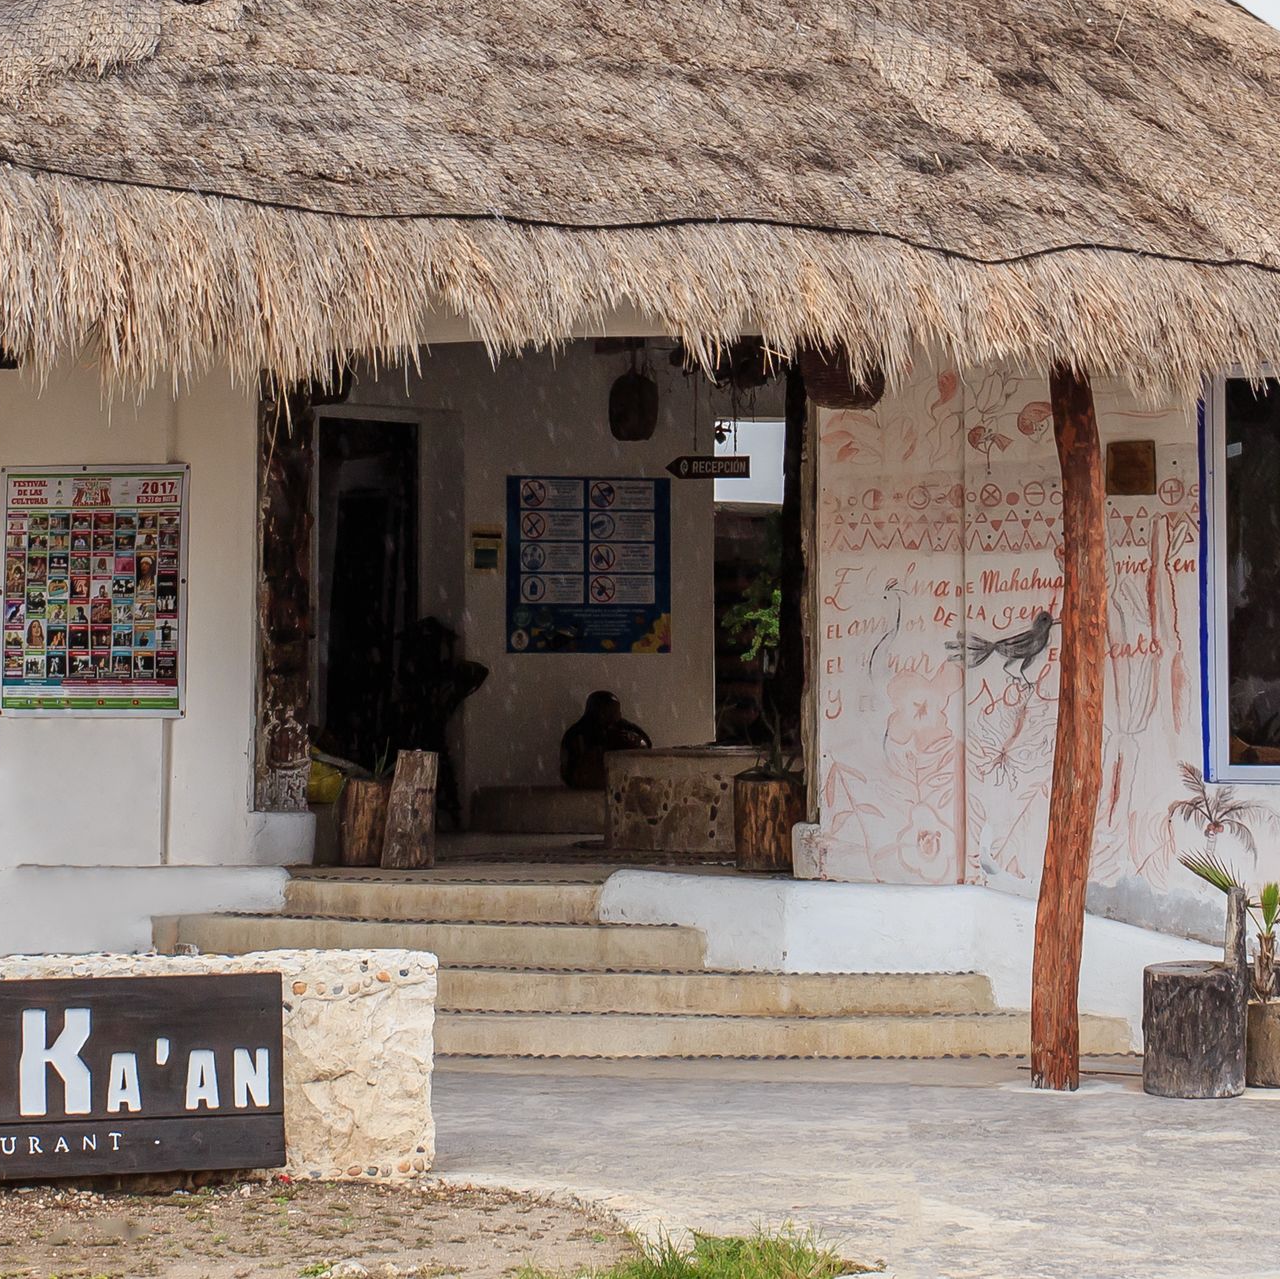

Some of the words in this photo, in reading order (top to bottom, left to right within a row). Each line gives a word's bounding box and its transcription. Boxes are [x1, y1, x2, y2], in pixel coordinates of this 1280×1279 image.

[692, 459, 746, 473] RECEPCIÓN
[13, 480, 48, 488] FESTIVAL
[141, 482, 175, 495] 2017
[11, 497, 48, 505] CULTURAS
[955, 580, 975, 598] DE
[981, 568, 1065, 593] Mahahua
[1173, 558, 1195, 572] en
[826, 623, 843, 640] EL
[933, 605, 958, 628] DE
[966, 603, 986, 621] LA
[992, 595, 1062, 630] gent
[21, 1007, 271, 1115] KA'AN
